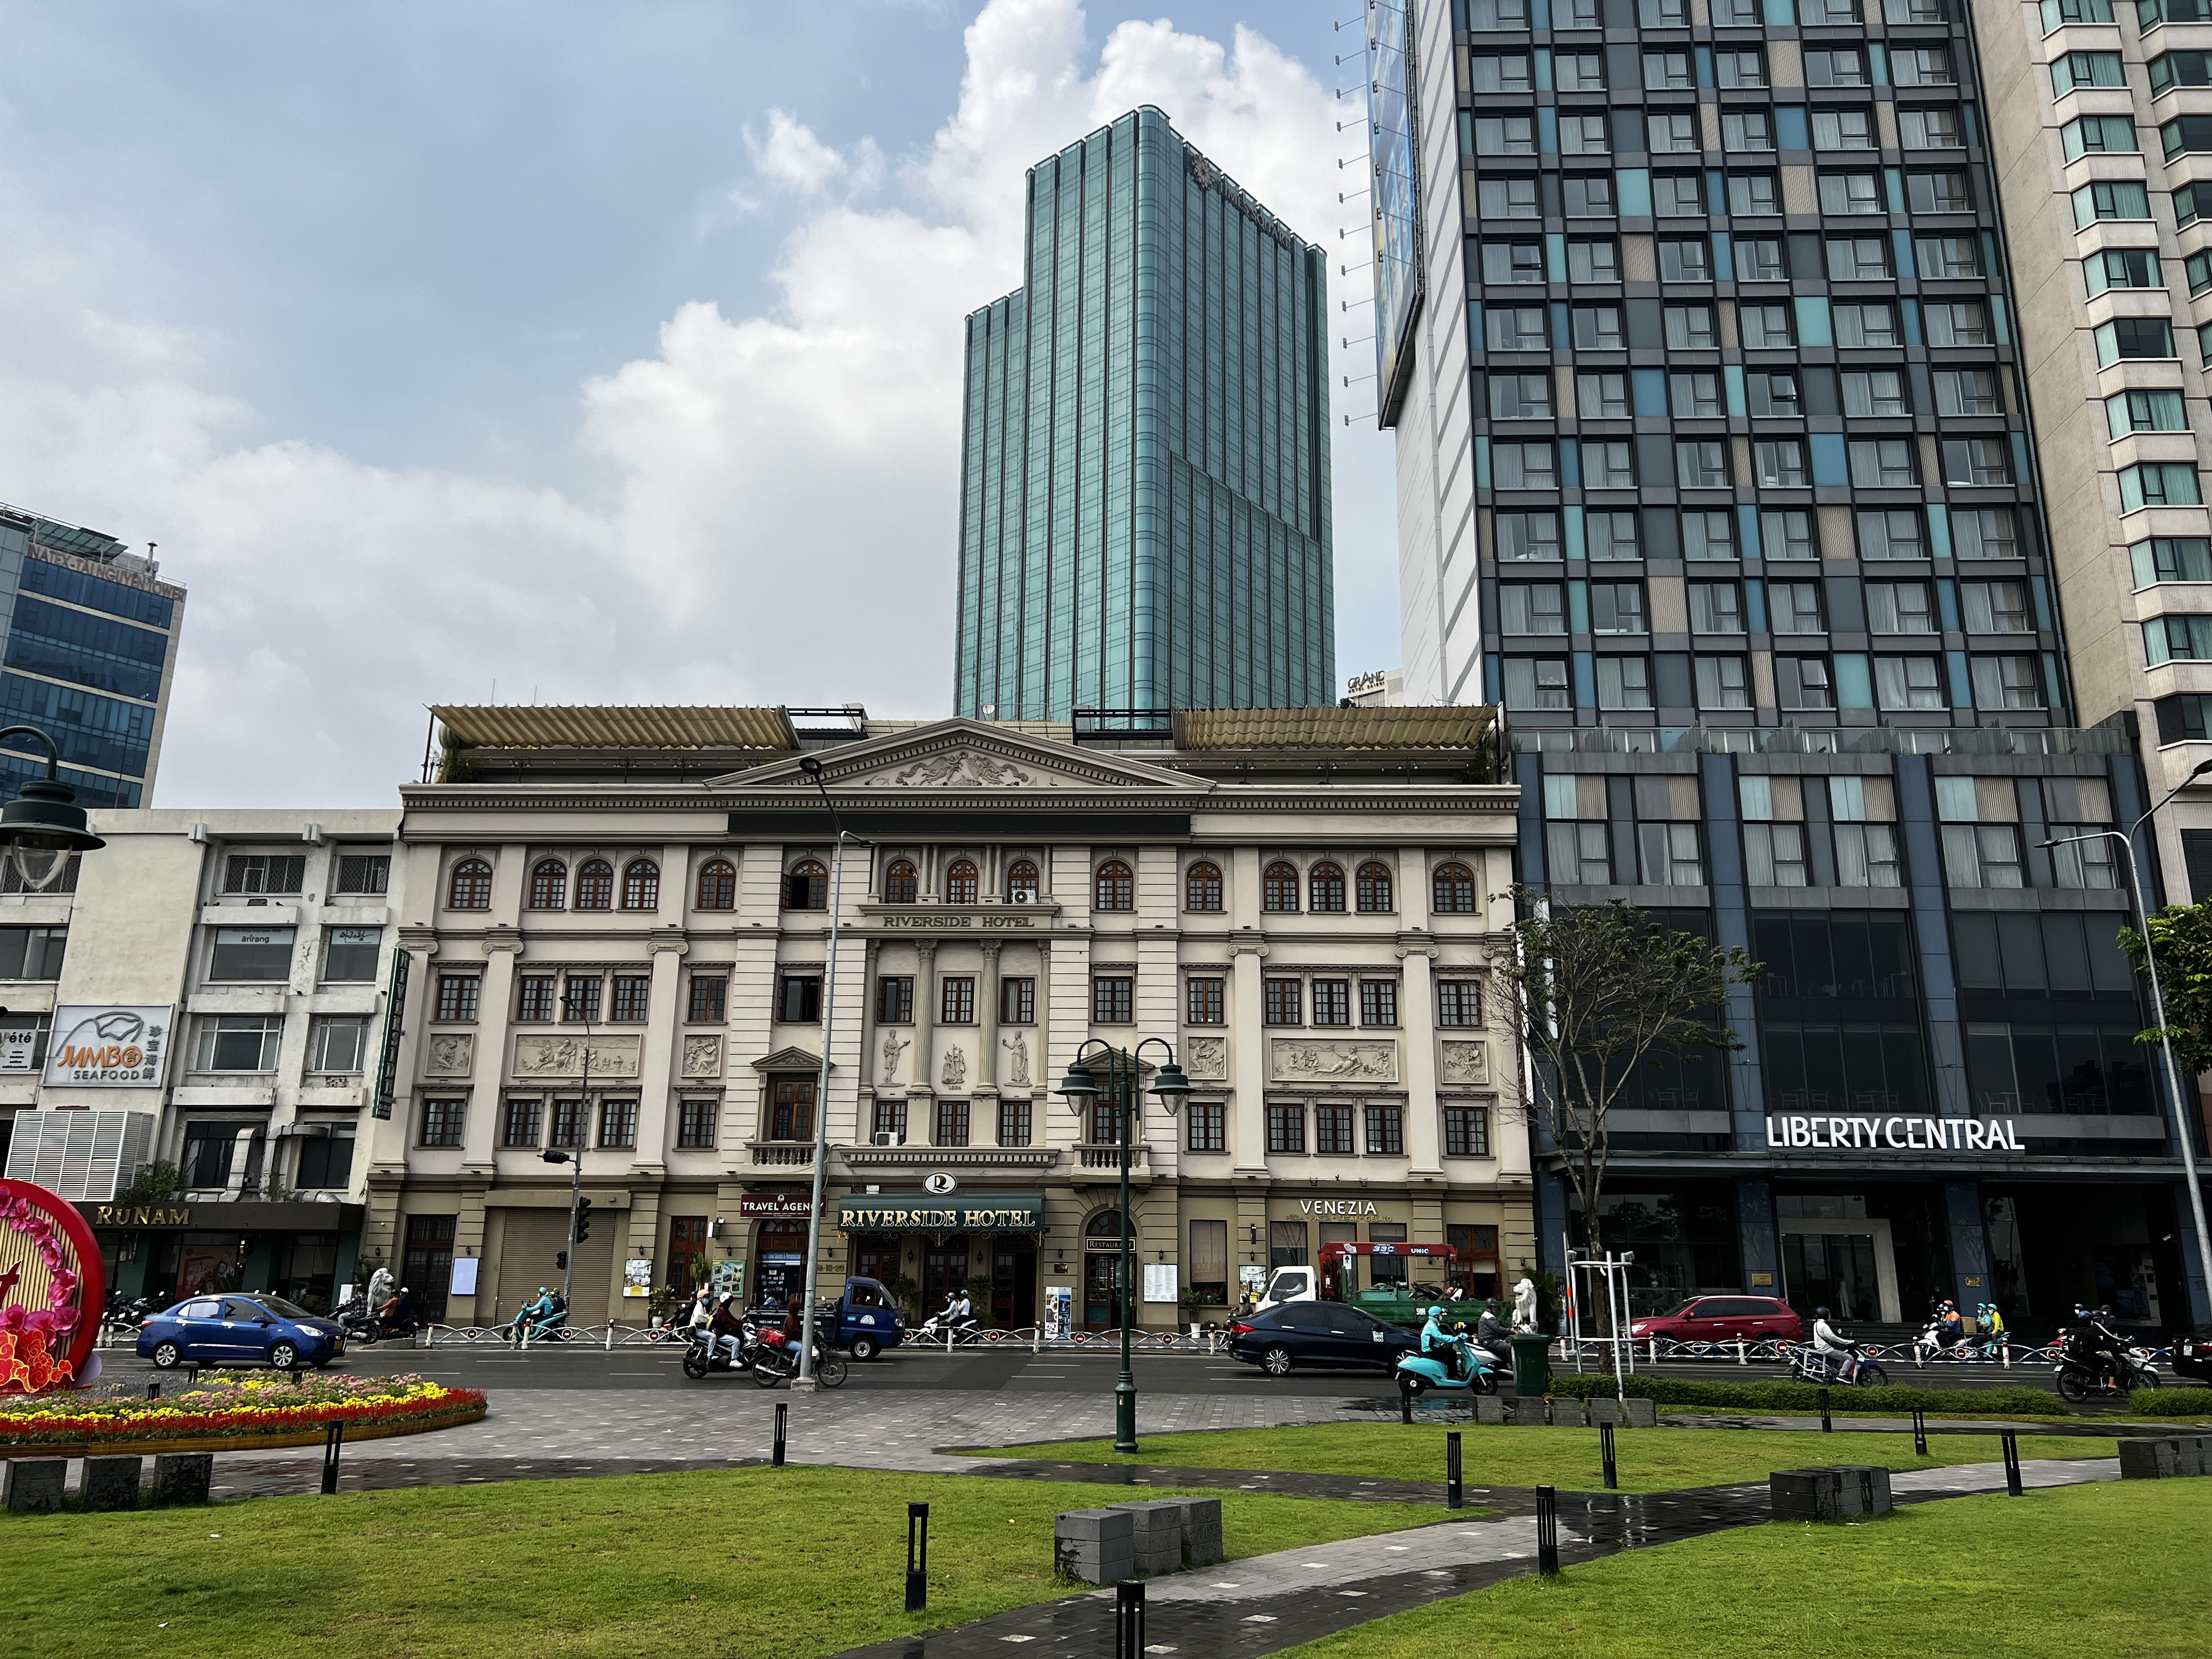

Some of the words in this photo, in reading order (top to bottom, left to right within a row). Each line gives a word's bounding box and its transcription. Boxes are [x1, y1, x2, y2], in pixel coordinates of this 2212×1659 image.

[1220, 180, 1249, 213] TIMES
[1251, 209, 1291, 248] SQUARE
[148, 580, 185, 603] TOWER
[1348, 670, 1385, 688] GRAND
[883, 916, 971, 927] RIVERSIDE
[982, 916, 1035, 927] HOTEL
[241, 934, 270, 943] arirang
[58, 1045, 142, 1067] JUMBO
[74, 1070, 139, 1079] SEAFOOD
[1765, 1116, 1881, 1148] LIBERTY
[1885, 1117, 2025, 1150] CENTRAL
[742, 1202, 779, 1211] TRAVEL
[782, 1202, 824, 1211] AGEN
[1300, 1200, 1377, 1215] VENEZIA
[841, 1209, 957, 1227] RIVERSIDE
[964, 1209, 1036, 1227] HOTEL
